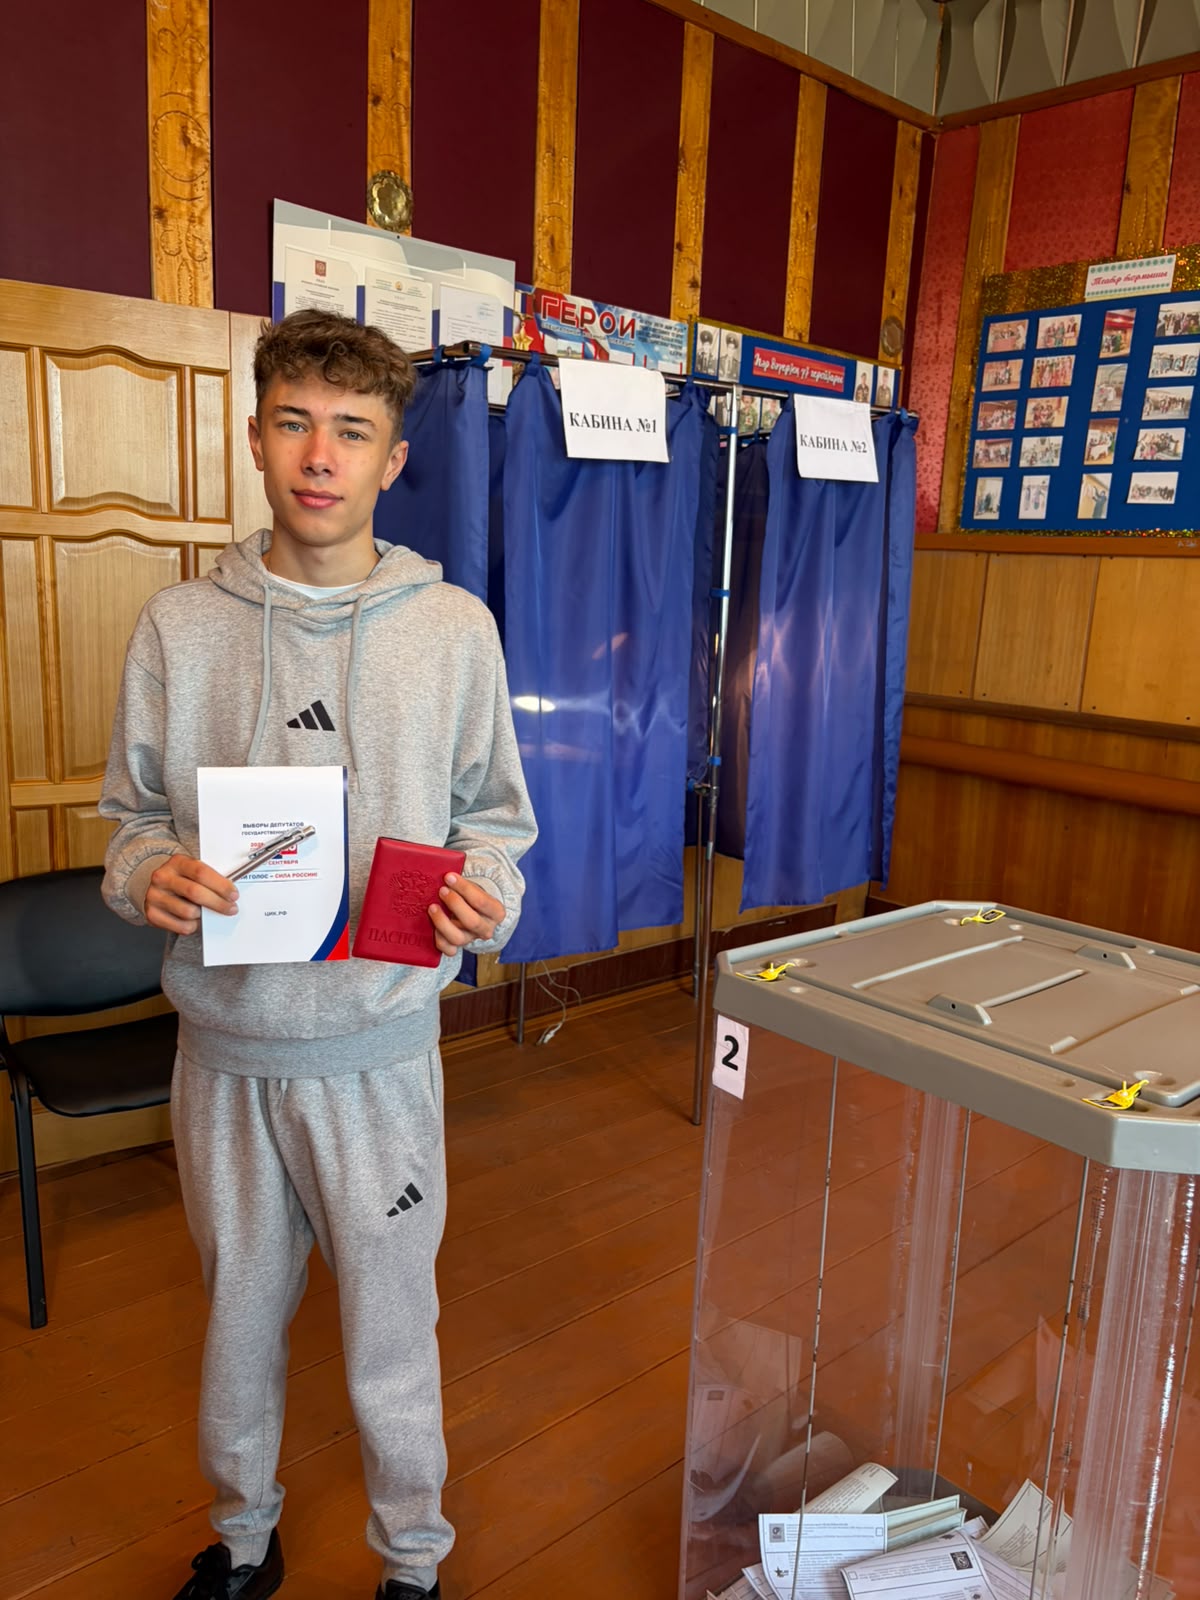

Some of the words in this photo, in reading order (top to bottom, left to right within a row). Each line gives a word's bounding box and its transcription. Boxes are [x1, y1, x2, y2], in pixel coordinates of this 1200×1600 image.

[540, 295, 636, 340] ГЕРОИ
[569, 411, 633, 432] КАБИНА
[636, 418, 657, 433] №1
[800, 433, 848, 451] КАБИНА
[850, 440, 868, 454] №2
[721, 1035, 739, 1071] 2
